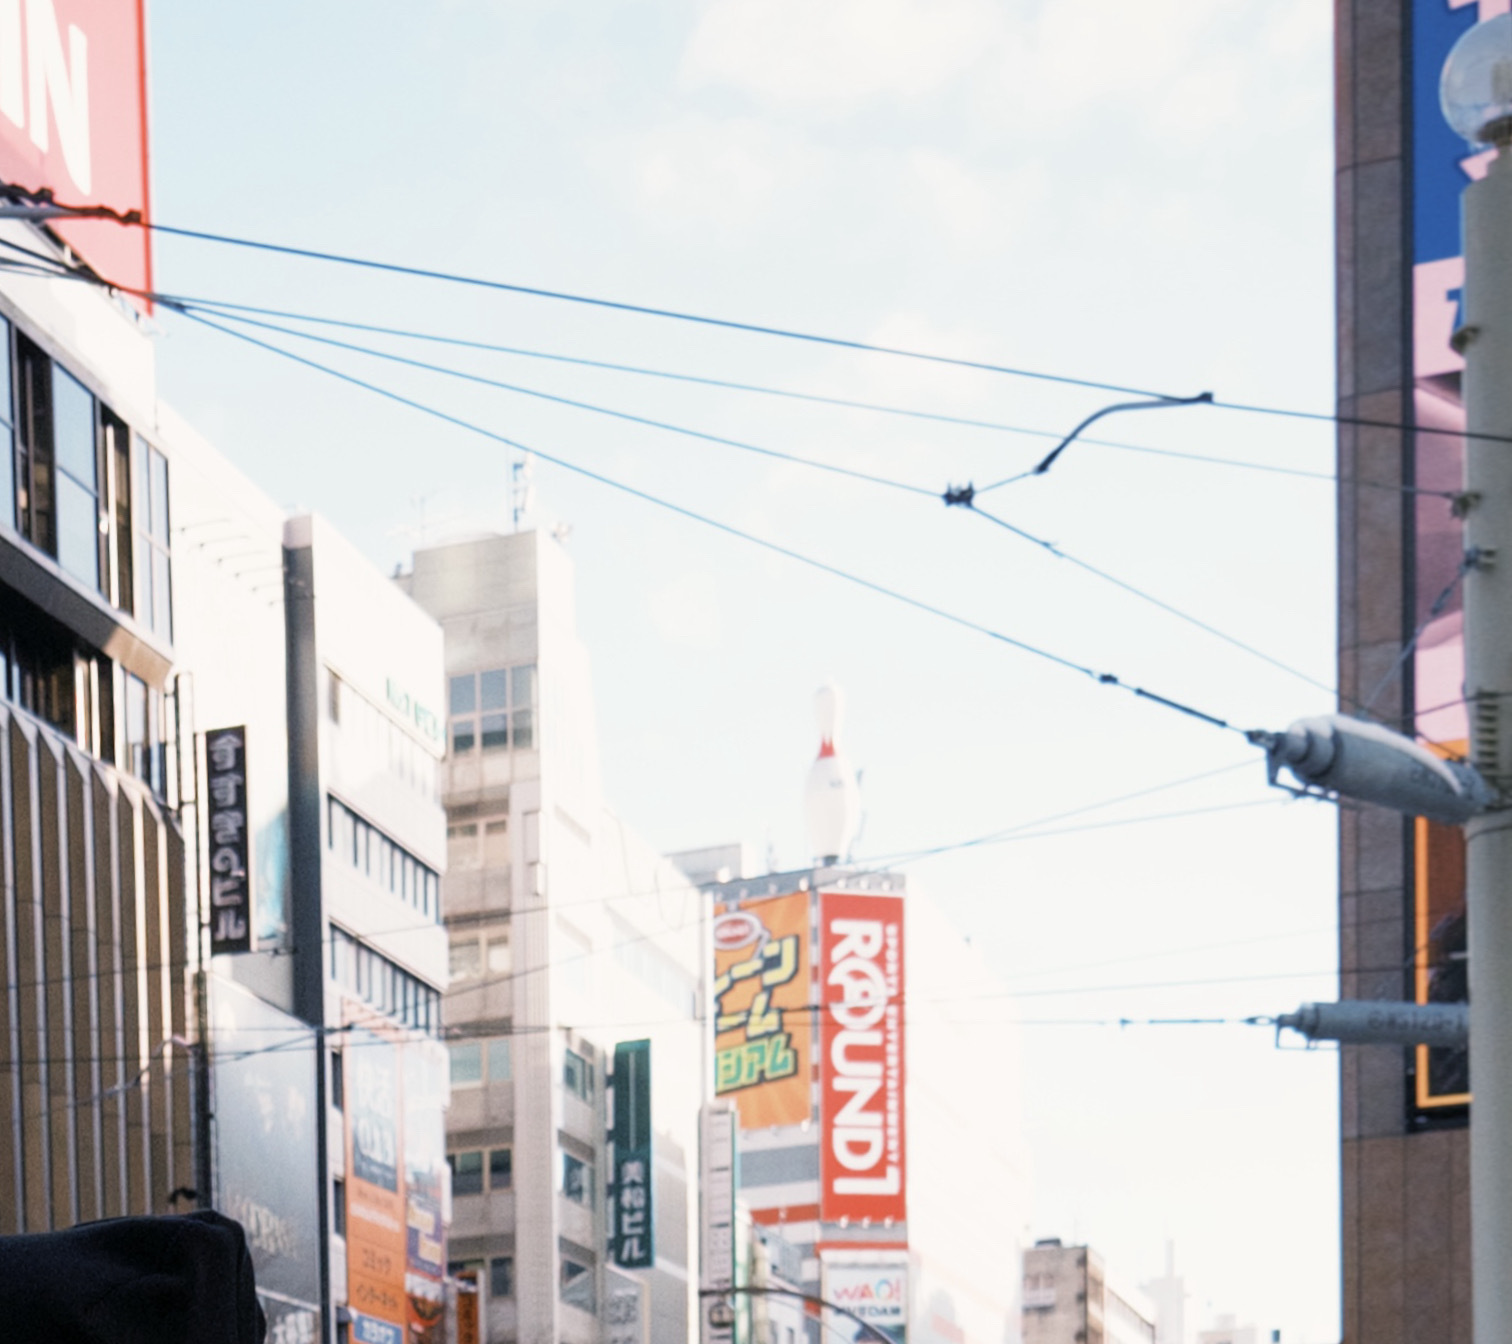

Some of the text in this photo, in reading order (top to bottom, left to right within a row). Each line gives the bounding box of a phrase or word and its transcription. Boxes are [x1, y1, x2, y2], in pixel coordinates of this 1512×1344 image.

[210, 734, 246, 942] すすきのビル
[716, 1032, 794, 1094] ジアム
[827, 918, 901, 1196] ROUND1
